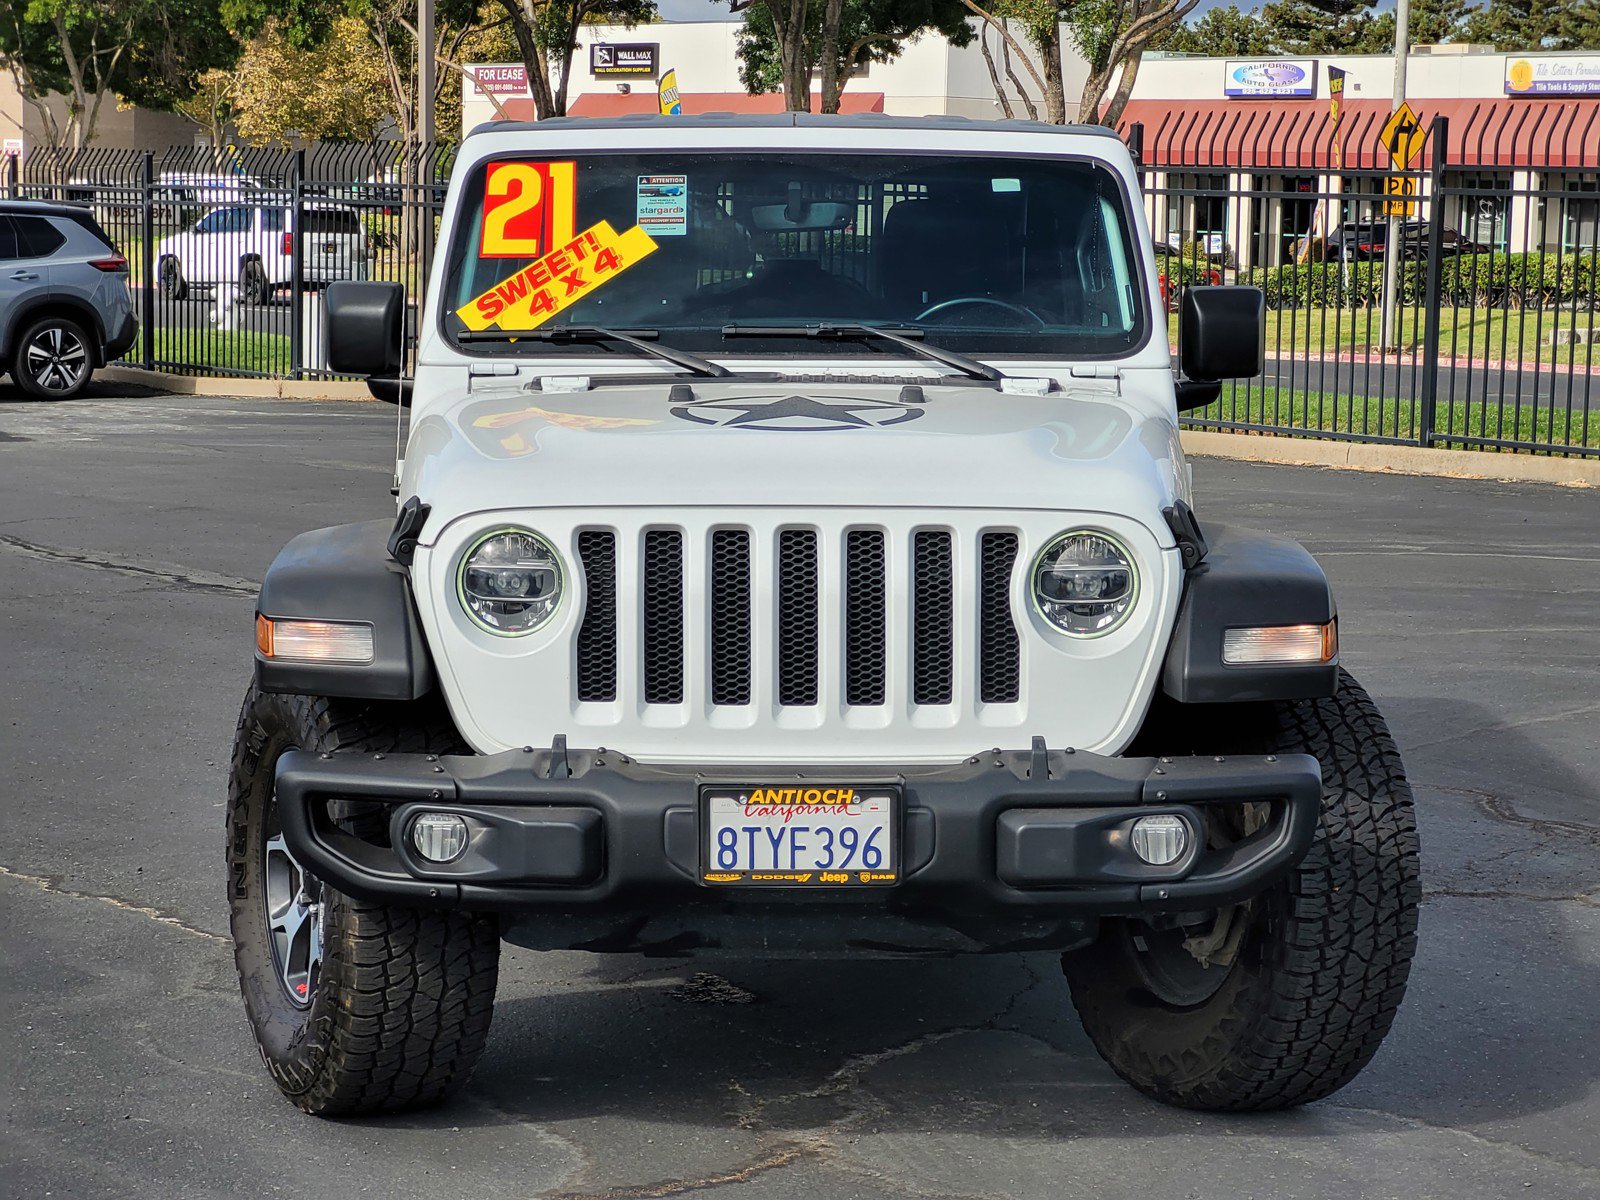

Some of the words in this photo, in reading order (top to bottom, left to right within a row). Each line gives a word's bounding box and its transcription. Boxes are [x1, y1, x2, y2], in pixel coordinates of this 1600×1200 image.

[617, 51, 635, 60] WALL
[636, 51, 652, 60] MAX
[479, 69, 495, 81] FOR
[497, 69, 523, 80] LEASE
[1242, 63, 1297, 74] CALIFORNIA
[1536, 63, 1548, 76] Tile
[1241, 78, 1265, 87] AUTO
[1268, 77, 1299, 88] GLASS
[1536, 83, 1547, 91] Tile
[1547, 83, 1561, 91] Tools
[1568, 82, 1587, 92] Supply
[481, 163, 574, 255] 21
[476, 231, 602, 321] SWEET!
[529, 288, 559, 318] 4
[594, 246, 623, 275] 4
[748, 789, 854, 804] ANTIOCH
[744, 804, 861, 823] California
[717, 826, 883, 870] 8TYF396
[819, 872, 849, 884] Jeep
